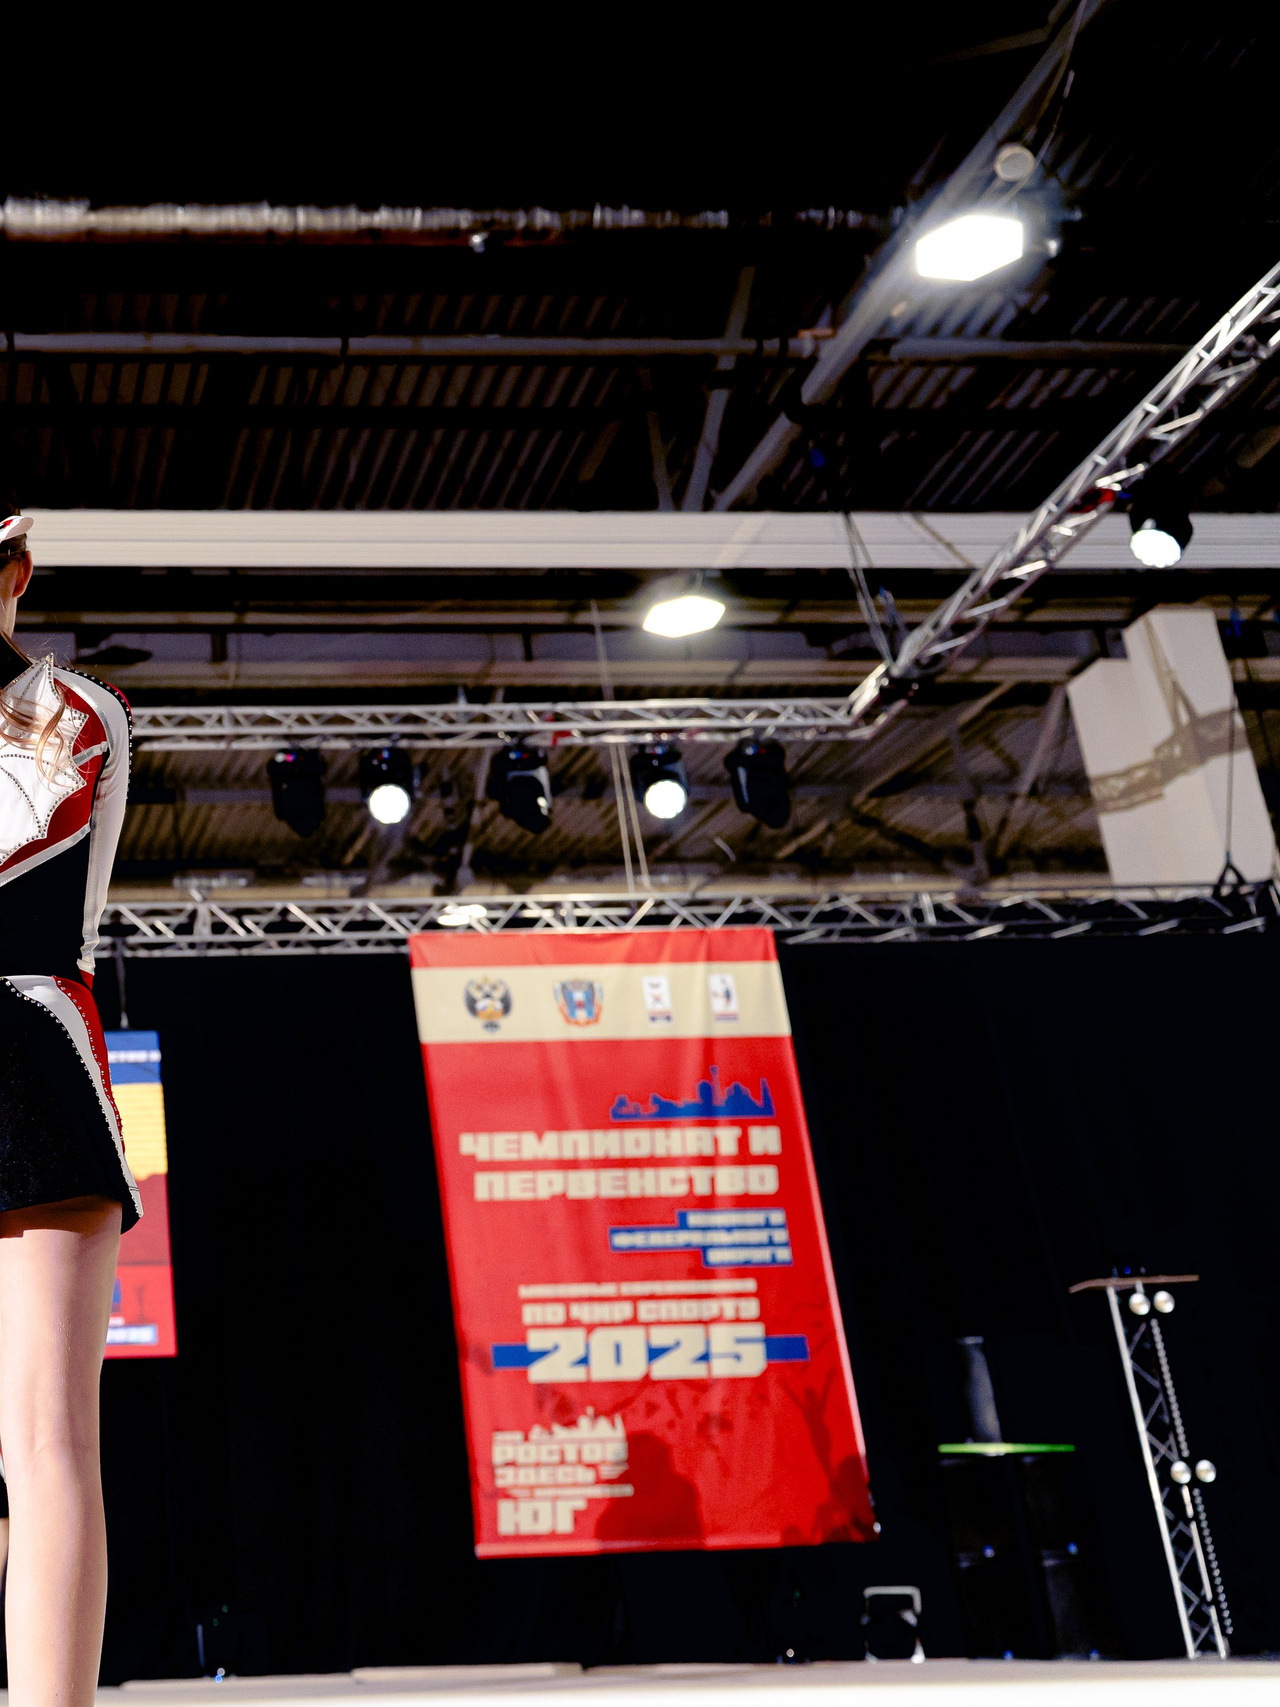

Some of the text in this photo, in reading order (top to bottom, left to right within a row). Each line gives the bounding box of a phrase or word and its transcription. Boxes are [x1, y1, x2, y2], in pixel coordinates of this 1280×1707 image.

[458, 1125, 782, 1161] ЧЕМПИОНАТ И
[474, 1164, 780, 1202] ПЕРВЕНСТВО
[522, 1303, 567, 1325] ПО
[637, 1299, 759, 1322] СПОРТУ
[527, 1323, 767, 1383] 2025
[498, 1500, 586, 1535] ЮГ
